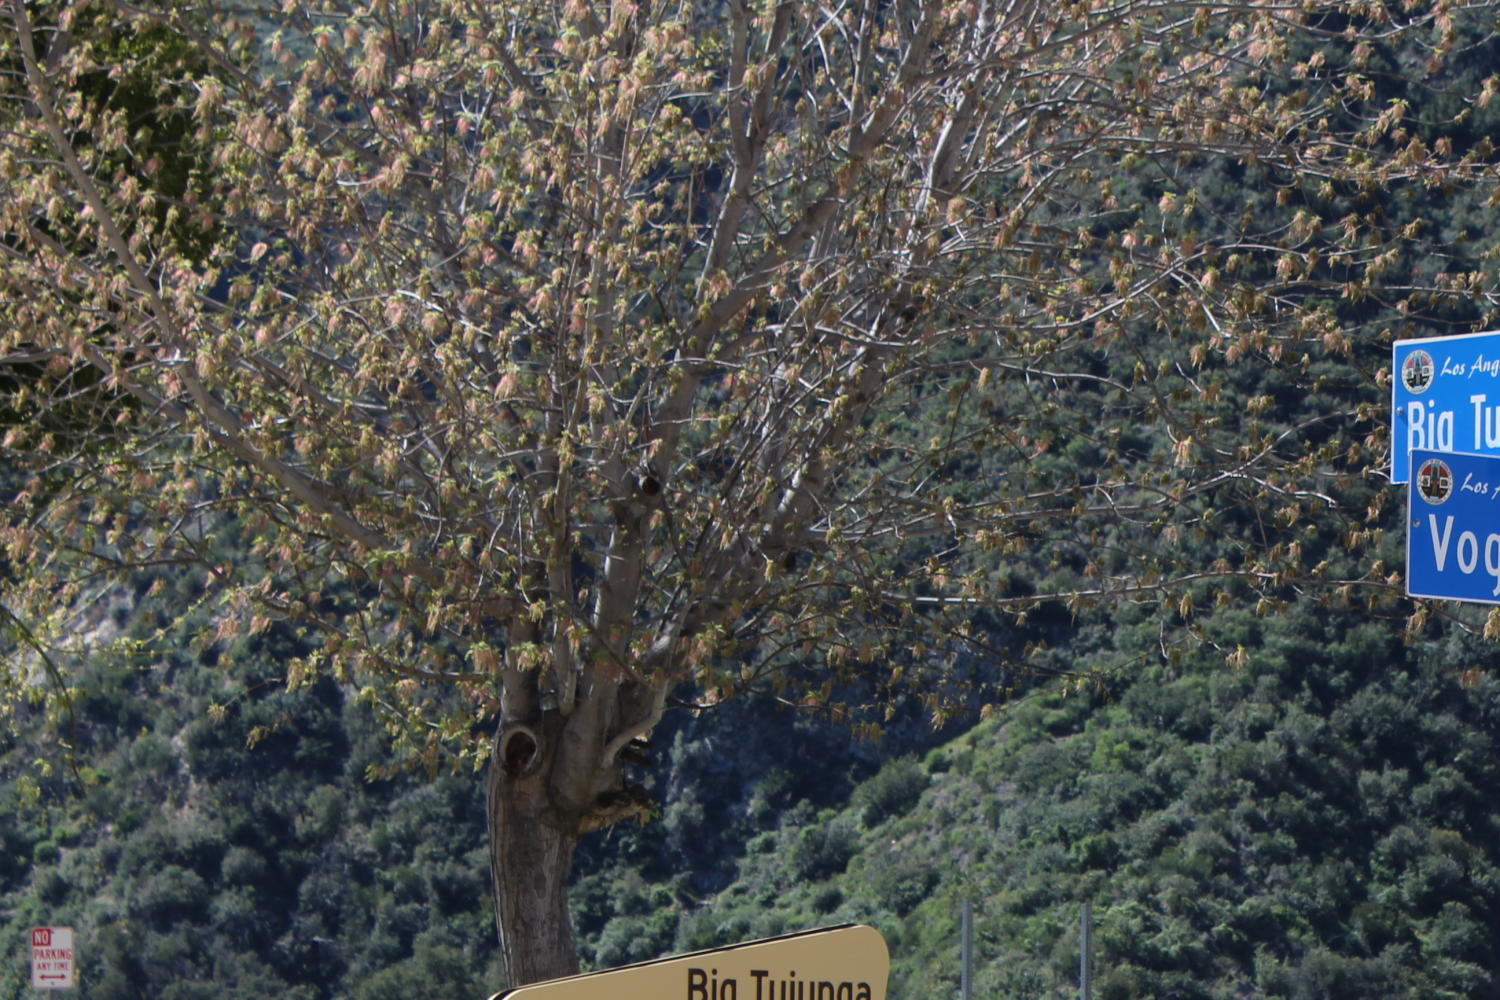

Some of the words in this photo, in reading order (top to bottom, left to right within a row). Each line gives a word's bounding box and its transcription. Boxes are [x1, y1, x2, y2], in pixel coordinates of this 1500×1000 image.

[1440, 357, 1466, 377] Los
[1460, 472, 1489, 494] Los
[34, 930, 48, 944] NO
[33, 949, 72, 960] PARKING
